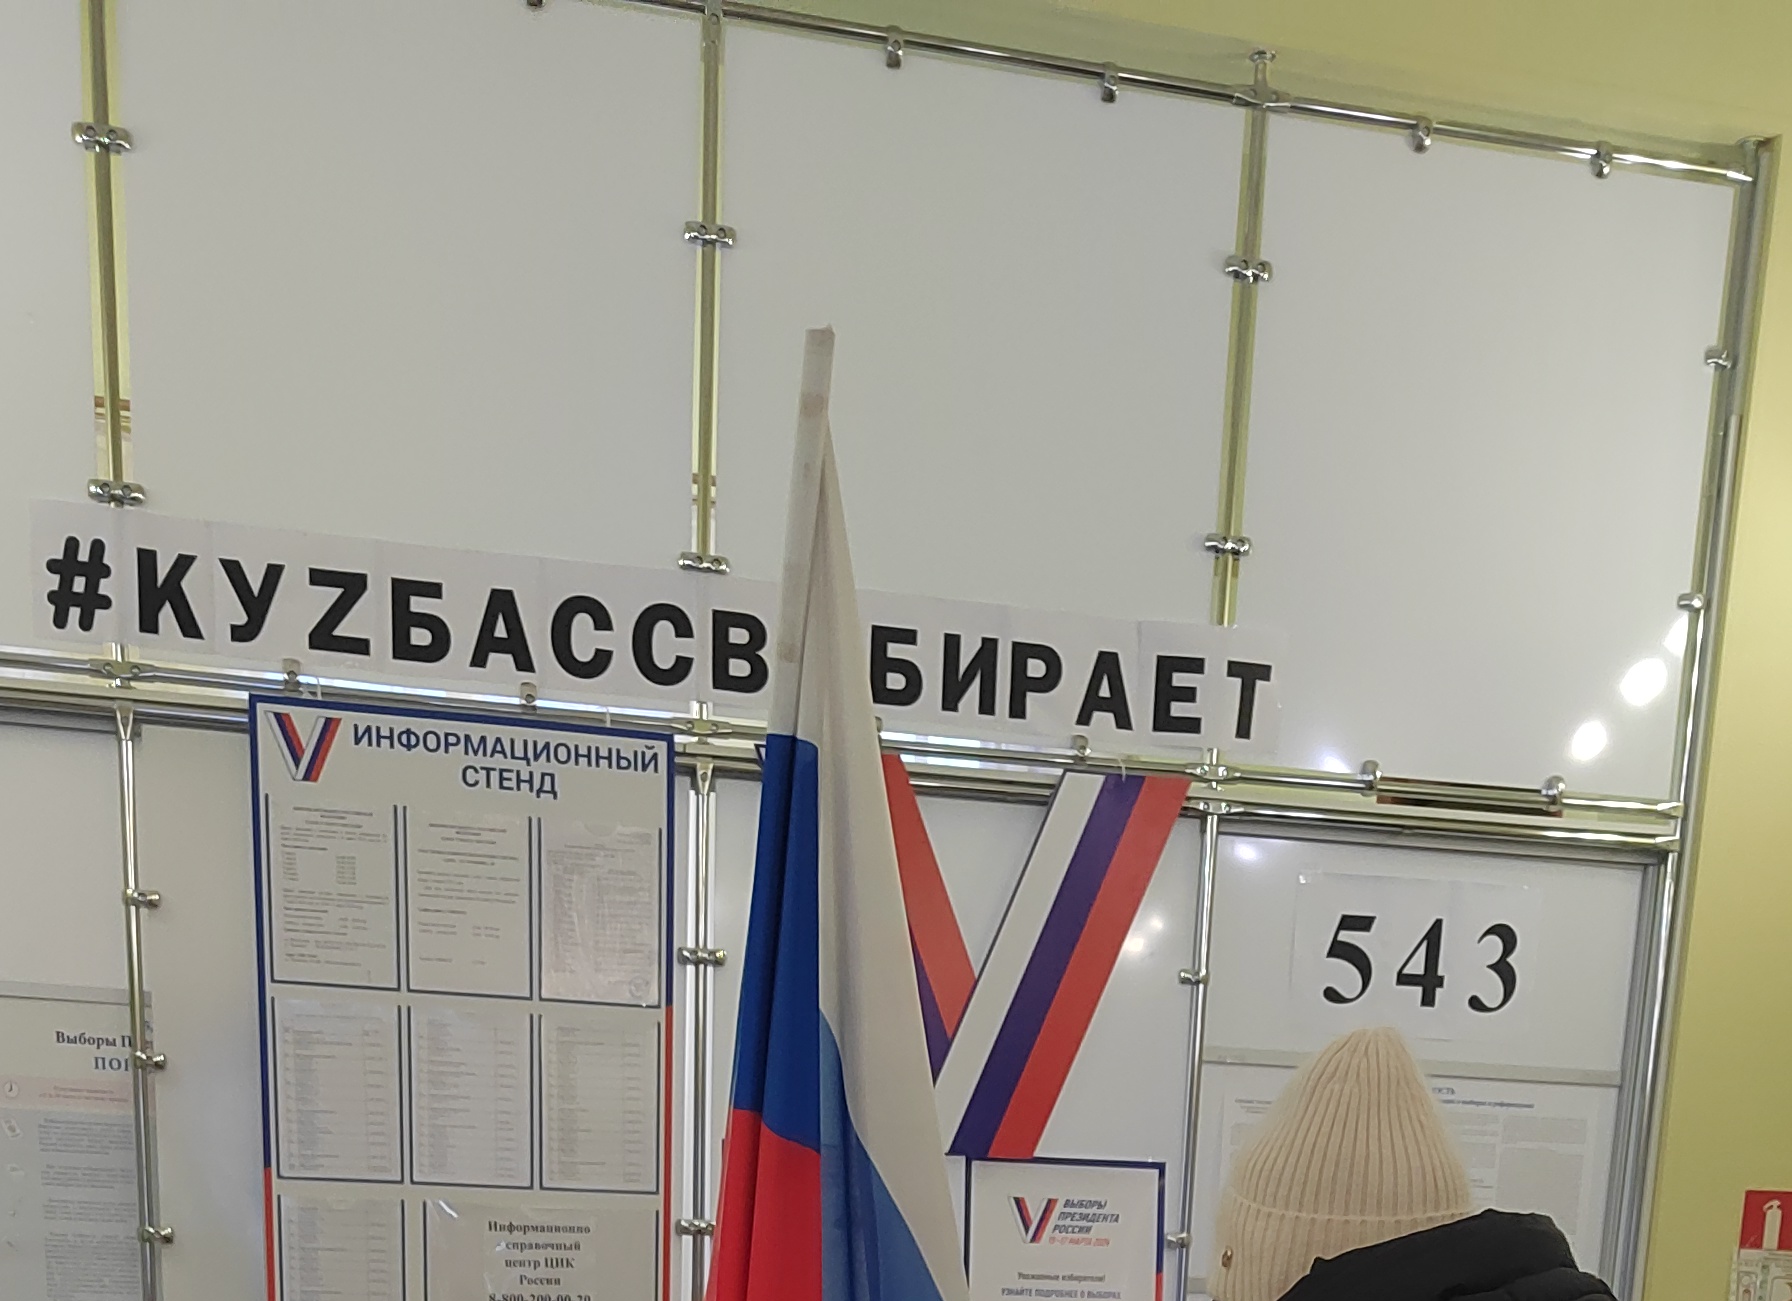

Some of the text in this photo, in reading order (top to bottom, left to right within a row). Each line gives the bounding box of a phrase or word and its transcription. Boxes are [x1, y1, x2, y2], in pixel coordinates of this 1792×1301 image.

[46, 535, 1272, 739] #КУZБАССВБИРАЕТ
[351, 722, 660, 775] ИНФОРМАЦИОННЫЙ
[460, 764, 559, 799] СТЕНД
[1322, 913, 1518, 1013] 543
[55, 1031, 117, 1049] Выборы
[1063, 1198, 1107, 1210] ВЫБОРЫ
[1058, 1211, 1120, 1224] ПРЕЗИДЕНТА
[488, 1220, 591, 1236] Информационно
[1052, 1224, 1093, 1235] РОССИИ
[505, 1240, 581, 1253] справочный
[504, 1257, 575, 1271] центр ЦИК
[519, 1274, 561, 1287] России
